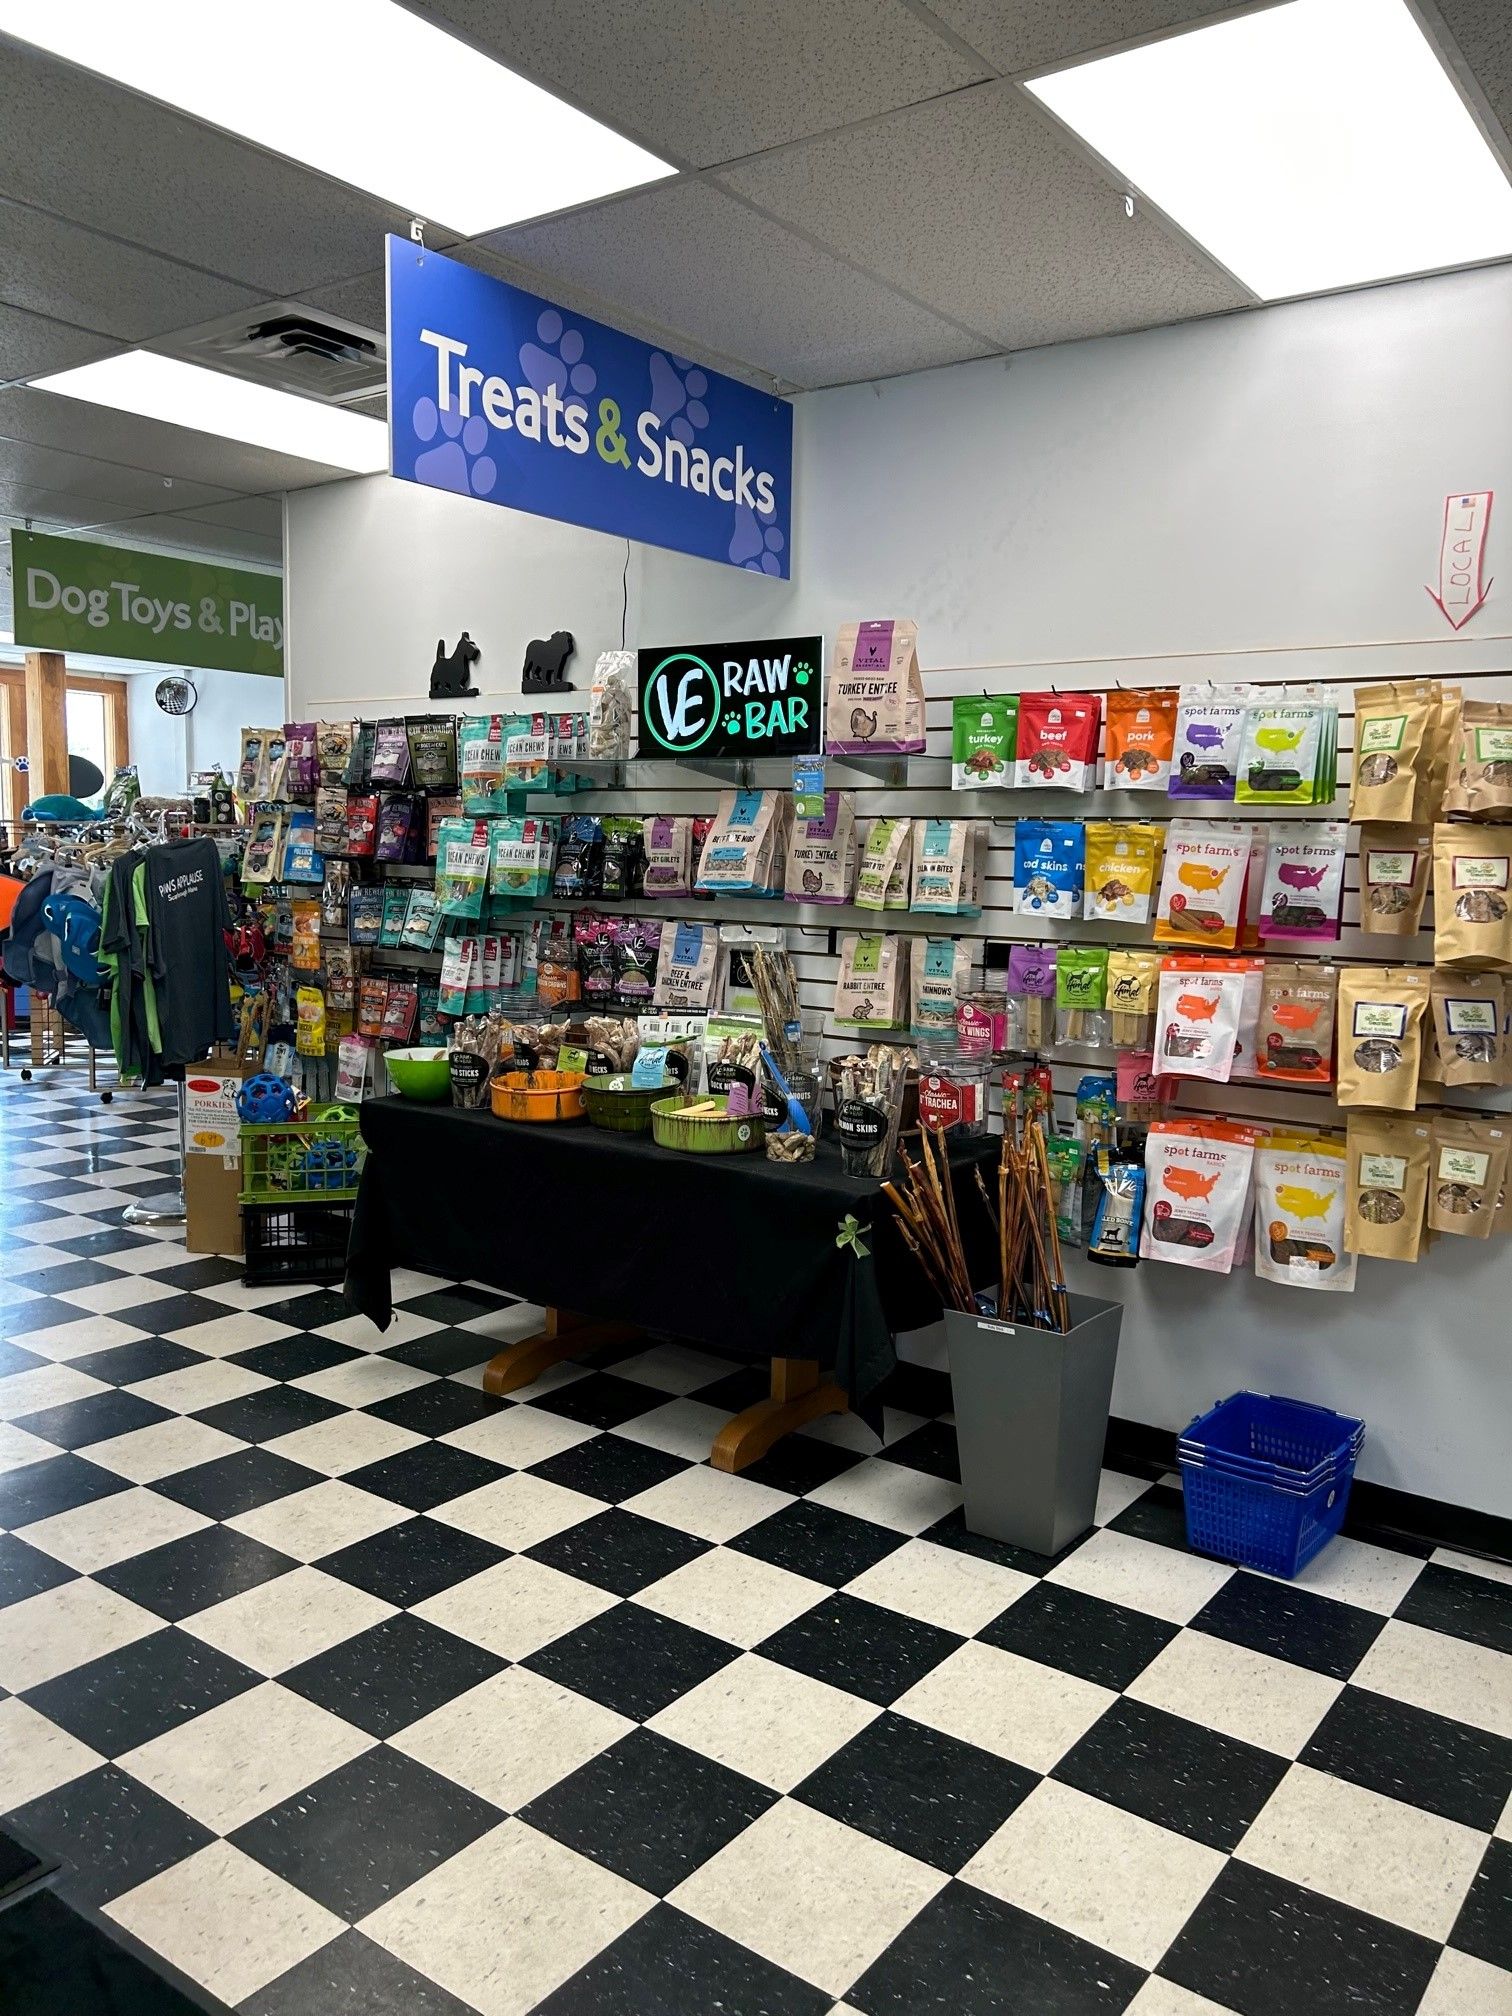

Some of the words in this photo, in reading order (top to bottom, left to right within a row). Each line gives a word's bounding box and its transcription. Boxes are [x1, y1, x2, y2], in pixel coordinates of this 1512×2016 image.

[419, 328, 590, 455] Treats
[594, 397, 631, 471] &
[636, 410, 776, 514] Snacks
[1449, 511, 1475, 605] LOCAL
[26, 567, 110, 628] Dog
[110, 581, 192, 635] Toys
[197, 597, 224, 636] &
[723, 654, 792, 697] RAW
[838, 683, 867, 695] TURKEY
[656, 668, 706, 741] VE
[1184, 707, 1207, 717] spot
[1209, 706, 1241, 716] farms
[1252, 708, 1277, 721] spot
[1279, 707, 1314, 718] farms
[745, 696, 809, 740] BAR
[968, 734, 1004, 745] turkey
[1039, 730, 1068, 741] beef
[1127, 732, 1155, 742] pork
[524, 741, 545, 753] CHEWS
[480, 748, 501, 761] CHEW
[514, 848, 535, 859] CHEWS
[1176, 843, 1202, 854] spot
[1204, 844, 1240, 857] farms
[1275, 845, 1300, 857] spot
[1302, 845, 1337, 856] farms
[463, 853, 486, 865] CHEWS
[1041, 860, 1068, 872] skins
[1099, 863, 1141, 873] chicken
[158, 880, 177, 898] PAWS
[176, 869, 204, 889] APPLAUSE
[679, 980, 704, 991] ENTREE
[843, 981, 862, 990] RABBIT
[863, 982, 886, 991] ENTREE
[922, 985, 952, 996] MINNOWS
[1269, 988, 1294, 998] spot
[1296, 988, 1330, 999] farms
[958, 1018, 983, 1026] Classic
[966, 1027, 990, 1038] WINGS
[459, 1069, 479, 1077] STICKS
[922, 1089, 951, 1098] Classic
[194, 1100, 233, 1108] PORKIES
[925, 1097, 958, 1110] TRACHEA
[856, 1123, 878, 1133] SKINS
[1164, 1144, 1190, 1159] spot
[1192, 1147, 1227, 1161] farms
[1274, 1162, 1302, 1175] spot
[1304, 1164, 1341, 1178] farms
[1115, 1216, 1135, 1226] BONE
